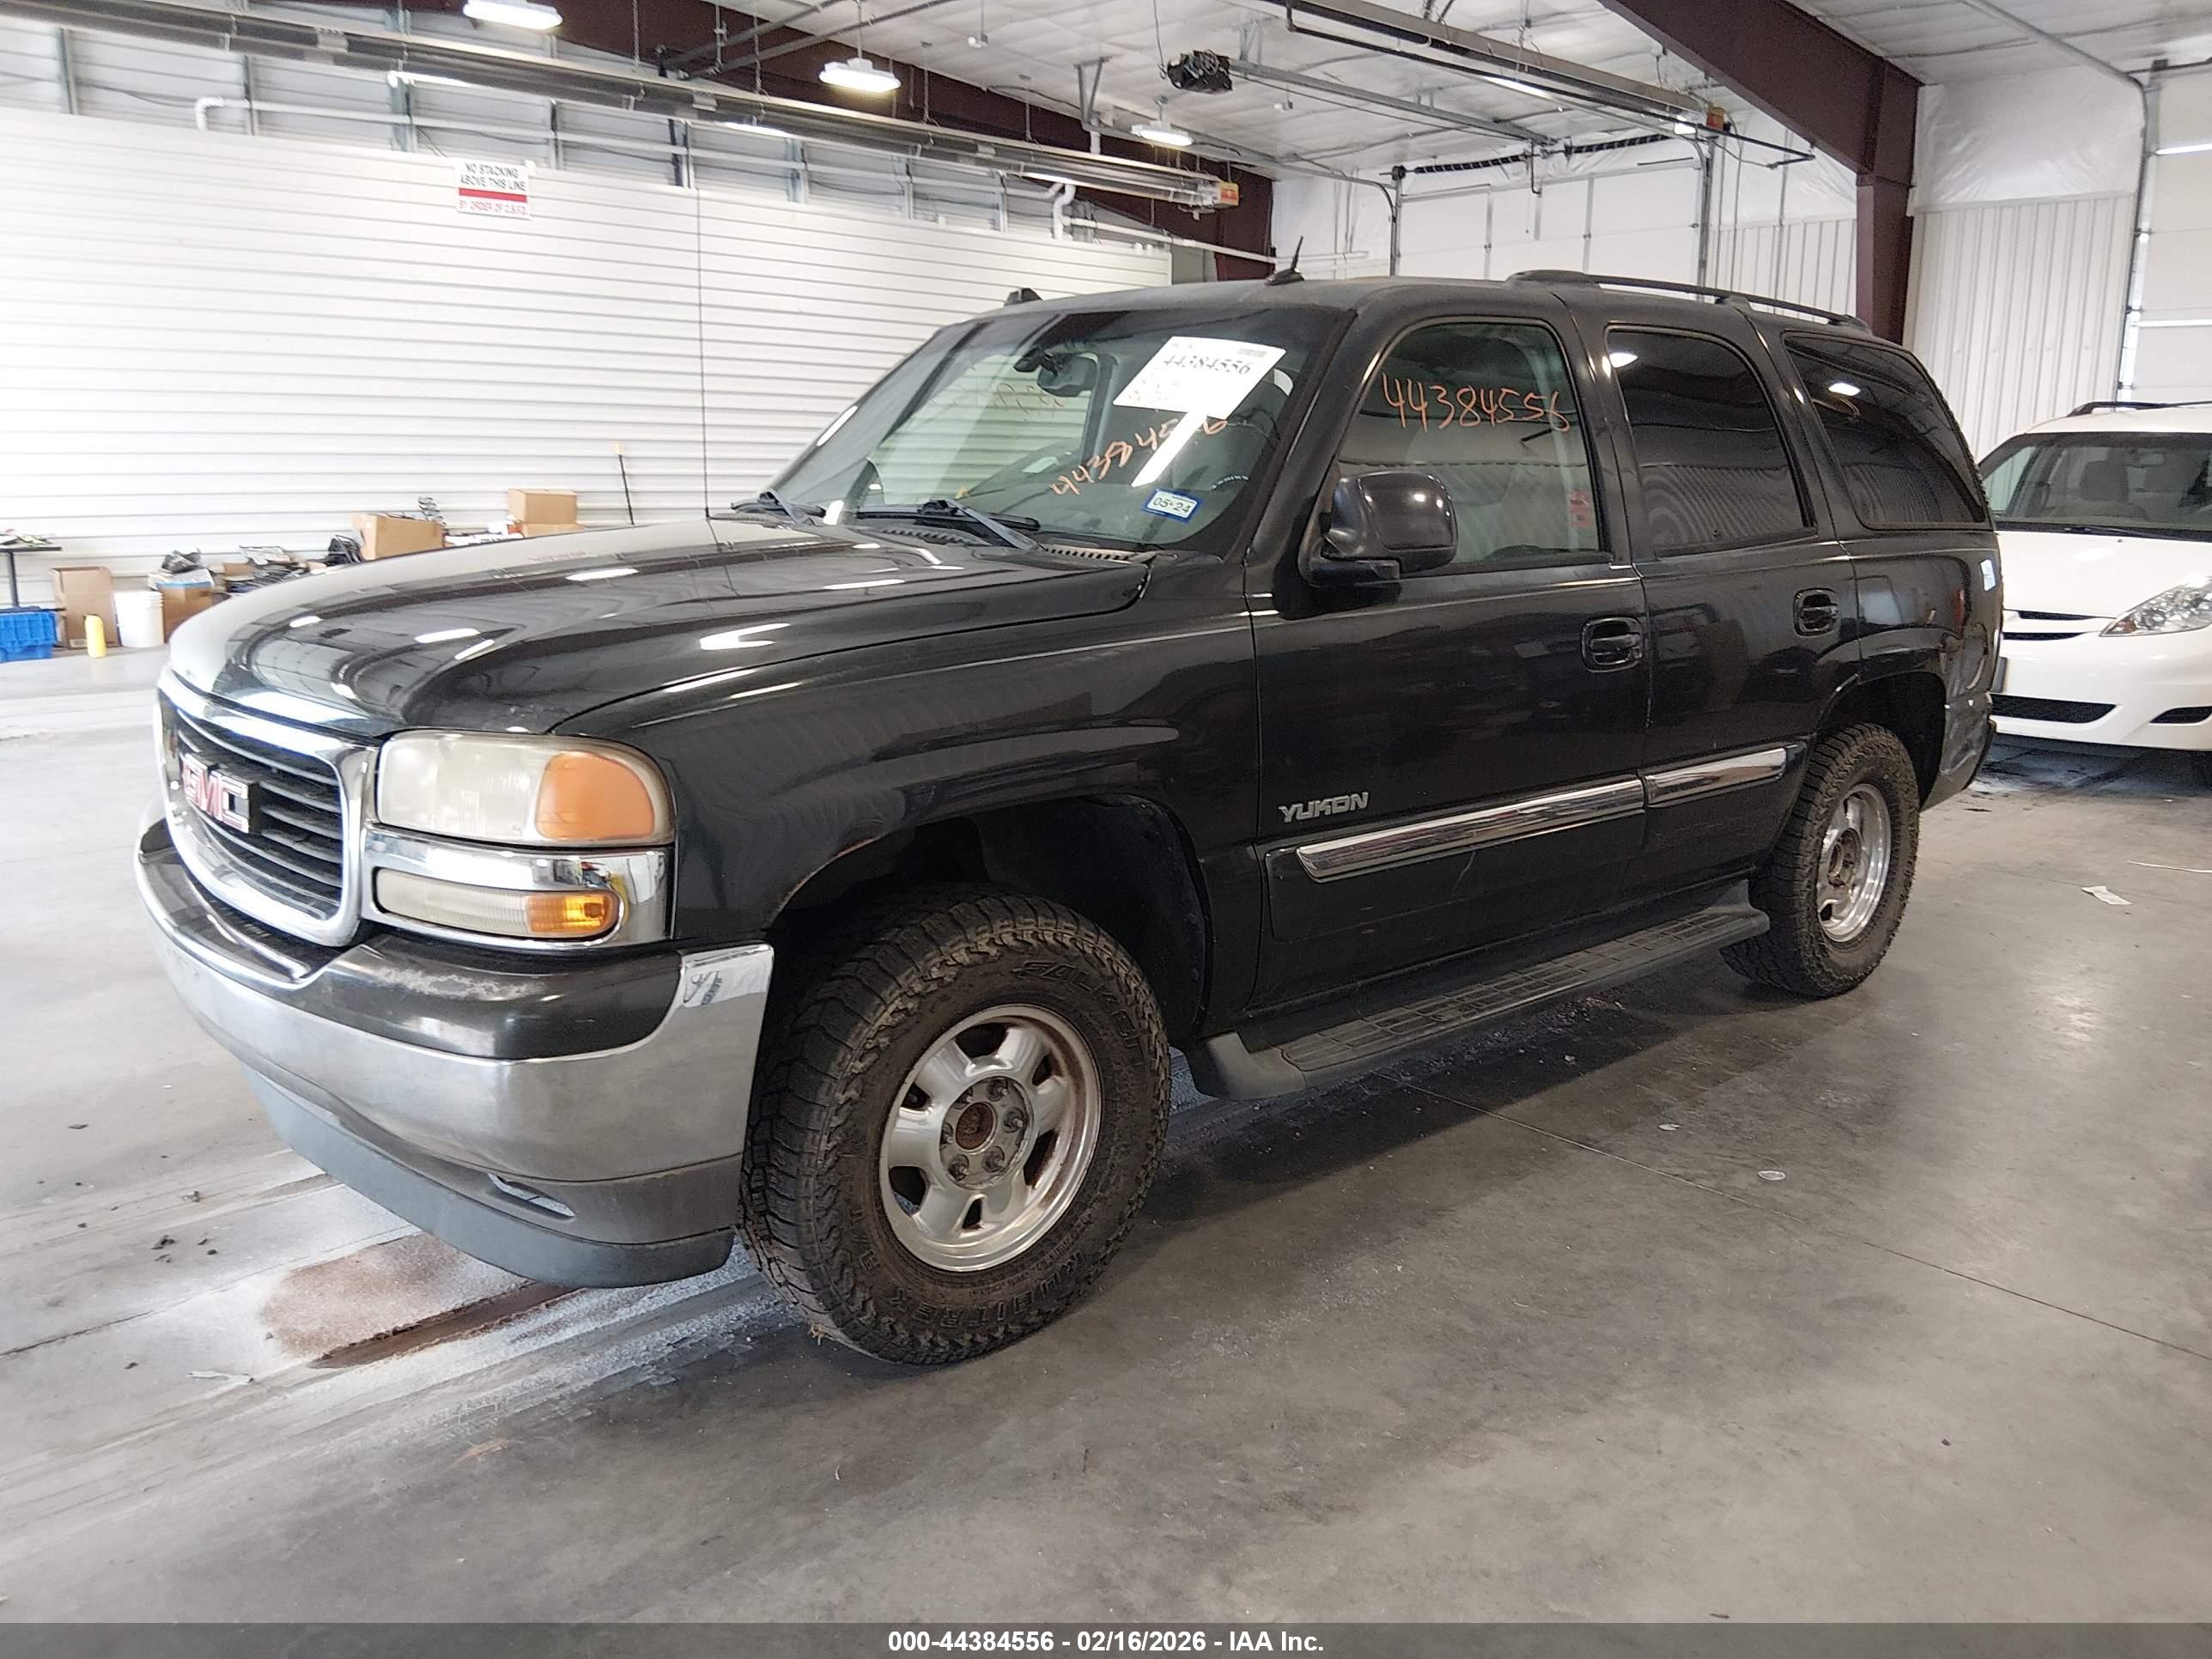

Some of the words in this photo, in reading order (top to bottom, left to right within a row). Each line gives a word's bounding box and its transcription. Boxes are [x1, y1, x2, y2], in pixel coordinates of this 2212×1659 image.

[480, 164, 519, 179] STACKING
[489, 177, 507, 189] THIS
[508, 180, 526, 191] LINE
[1382, 373, 1570, 432] 44384556
[179, 753, 249, 834] GMC
[1278, 791, 1370, 823] YUKON
